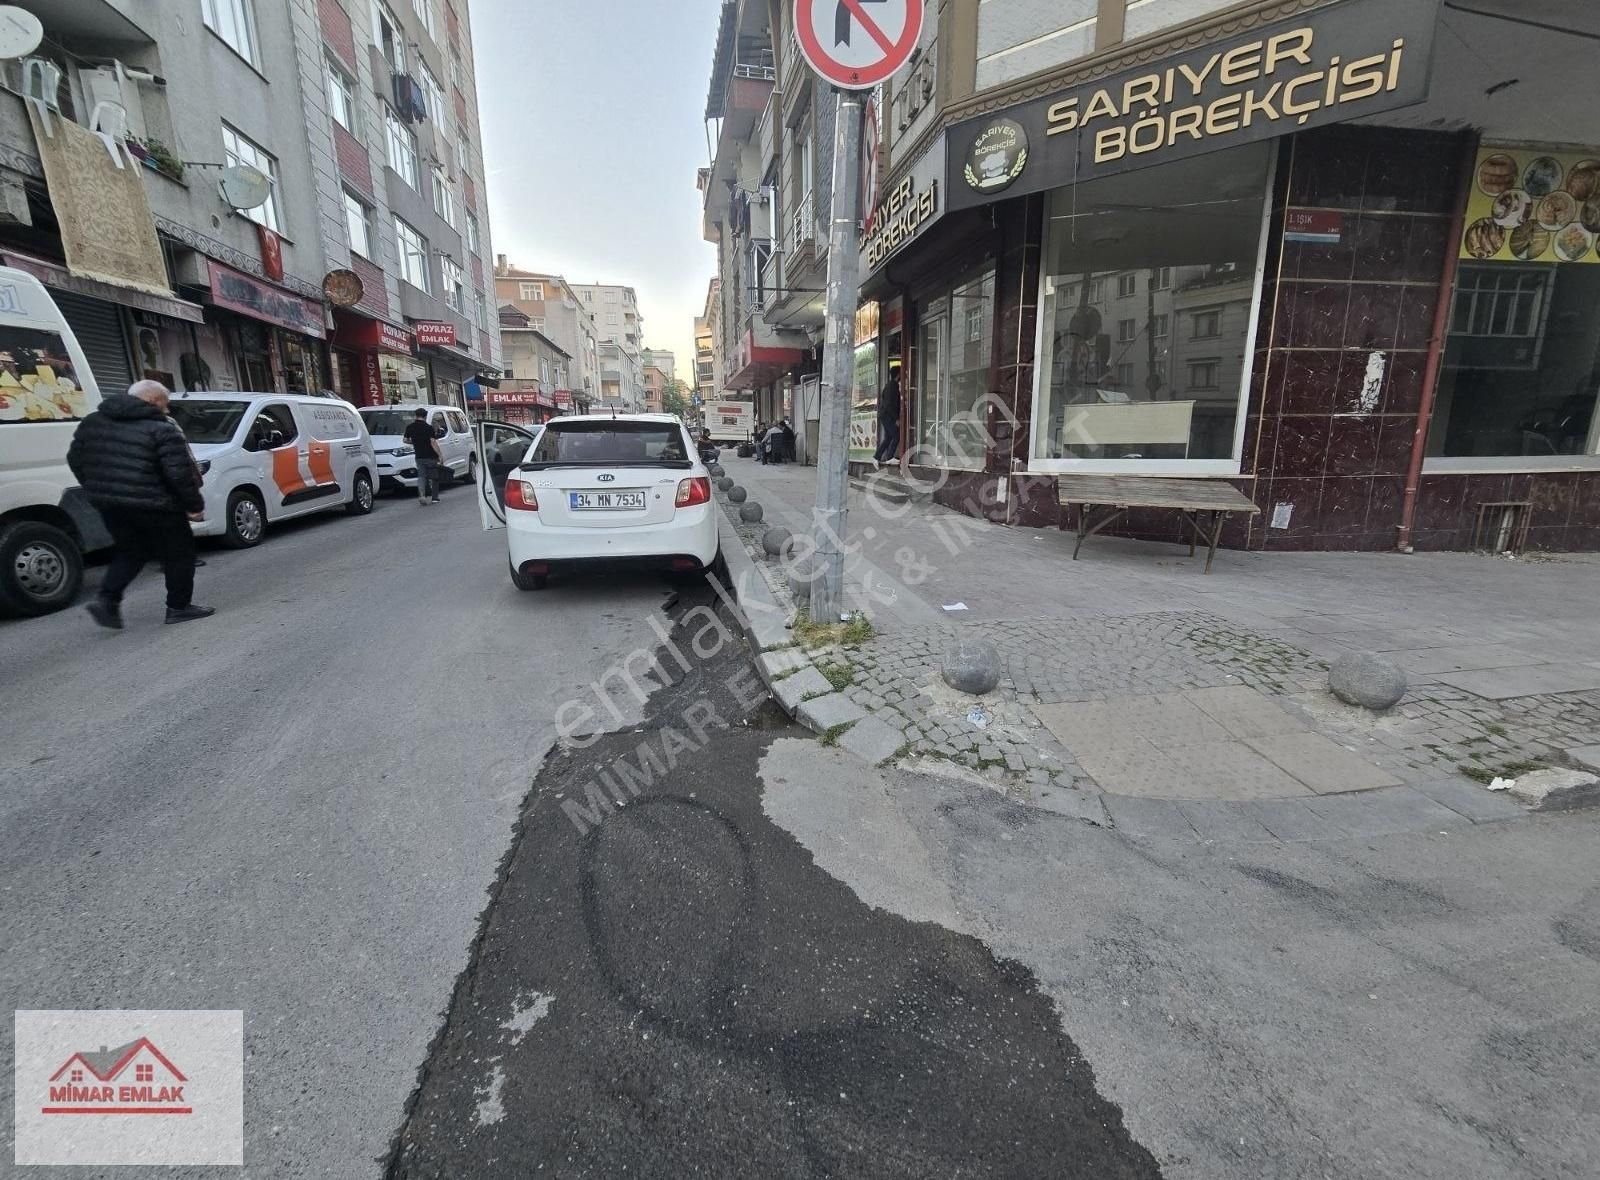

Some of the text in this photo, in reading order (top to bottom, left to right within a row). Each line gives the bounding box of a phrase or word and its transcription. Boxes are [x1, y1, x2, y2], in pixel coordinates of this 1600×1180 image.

[1046, 27, 1314, 136] SARIYER
[1094, 38, 1404, 164] BÖREKÇİSİ
[974, 125, 1016, 147] SARIYER
[867, 177, 935, 269] BÖREKÇİSİ
[417, 324, 454, 334] POYRAZ
[421, 335, 450, 344] EMLAK
[493, 394, 523, 402] EMLAK
[577, 493, 643, 507] 34 MN 7534
